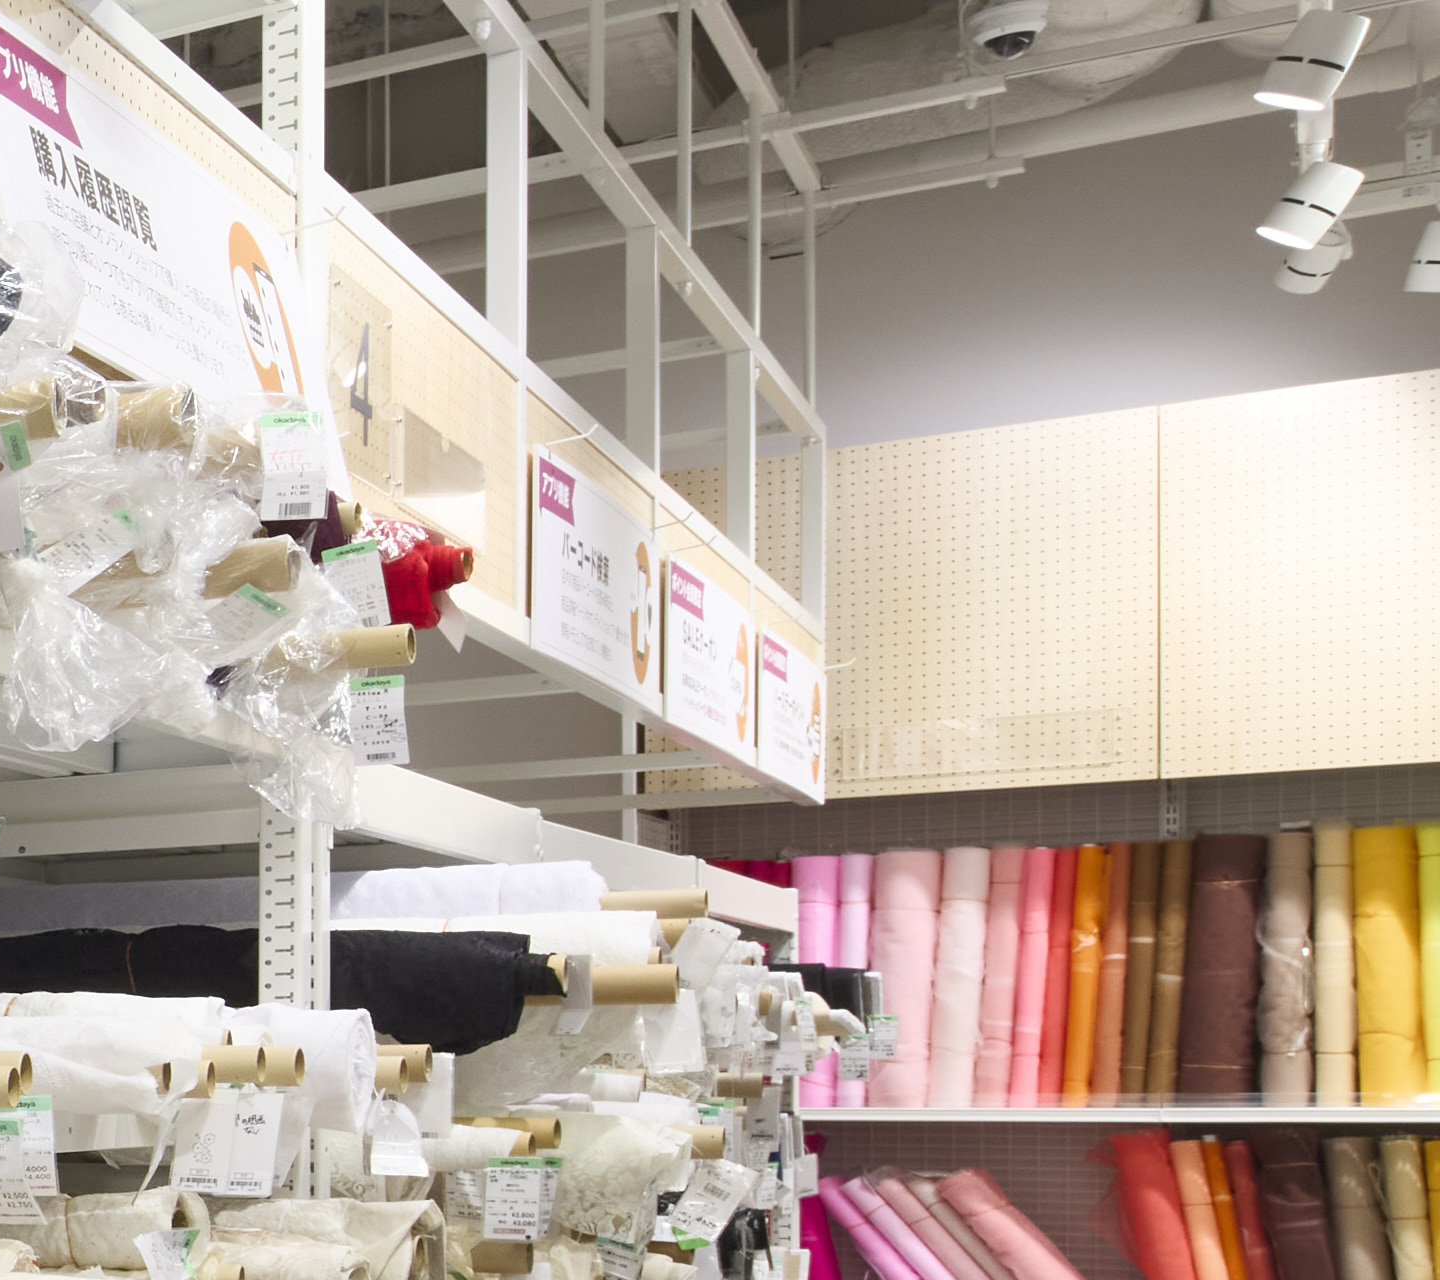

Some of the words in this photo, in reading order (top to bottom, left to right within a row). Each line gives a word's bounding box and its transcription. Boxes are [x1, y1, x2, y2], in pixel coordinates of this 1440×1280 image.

[28, 125, 159, 252] 購入履歴閲覧
[352, 322, 375, 448] 4
[562, 532, 610, 587] バーコード検索
